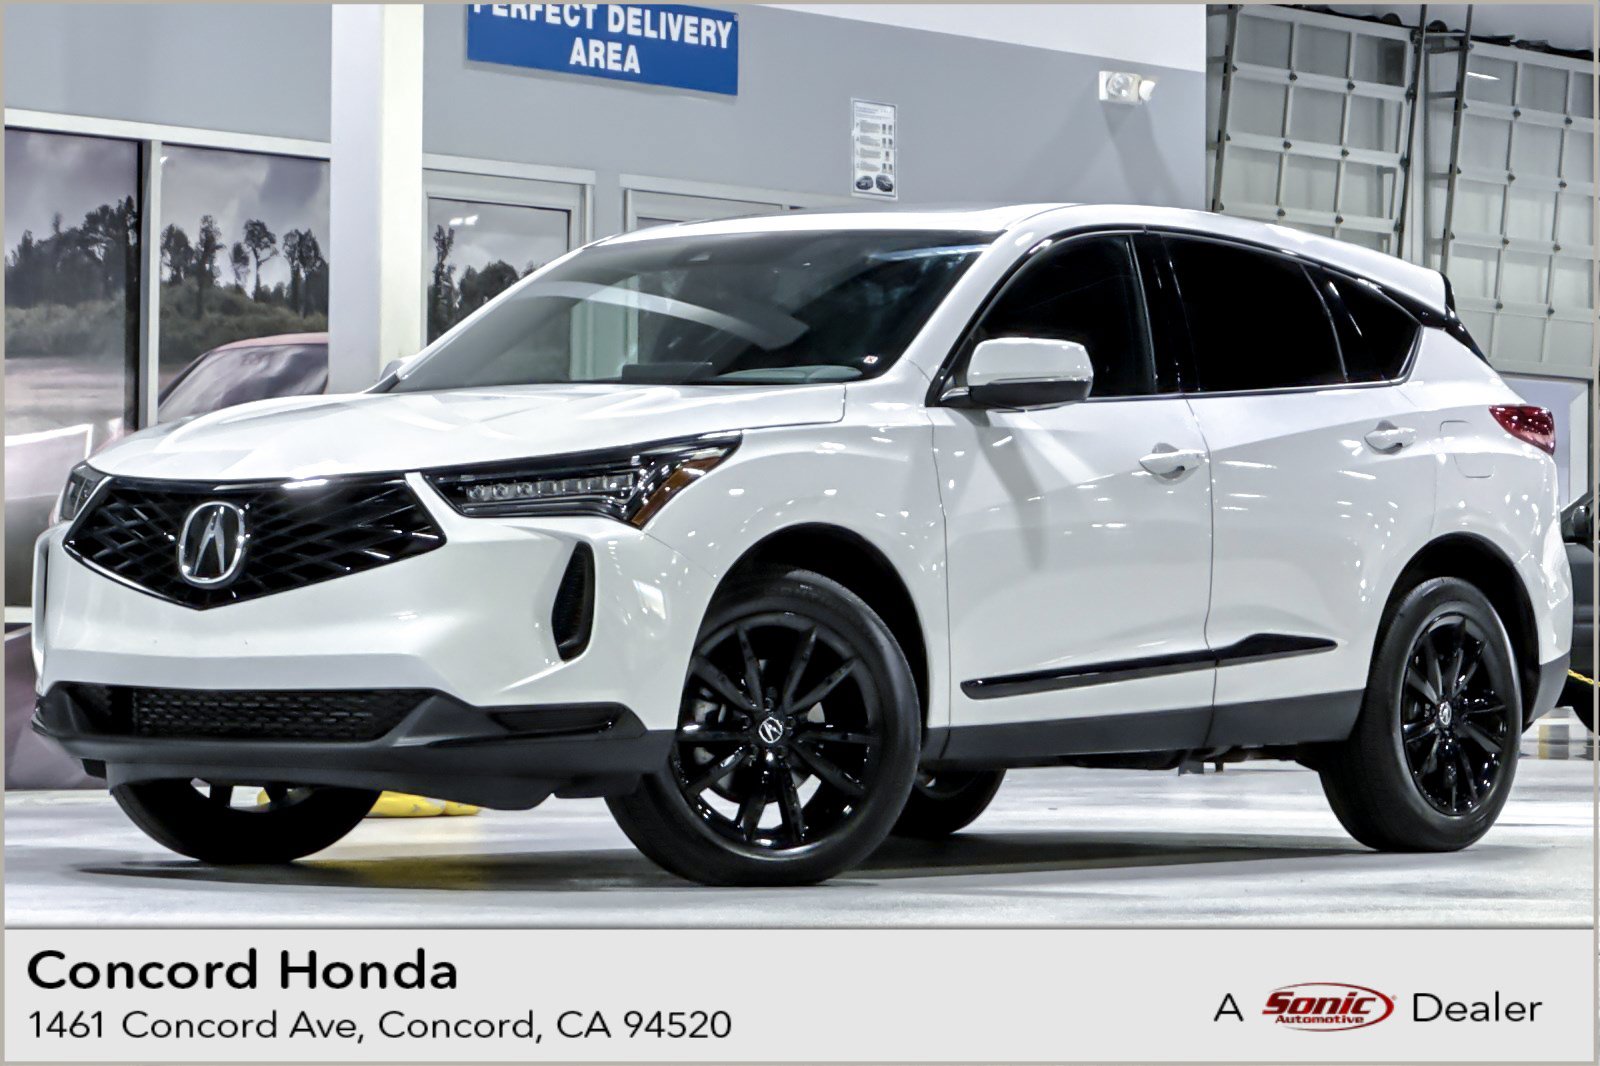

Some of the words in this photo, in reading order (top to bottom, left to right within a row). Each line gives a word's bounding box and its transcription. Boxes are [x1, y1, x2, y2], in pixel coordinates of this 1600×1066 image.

[474, 4, 597, 29] RFECT
[608, 5, 732, 49] DELIVERY
[569, 37, 641, 74] AREA
